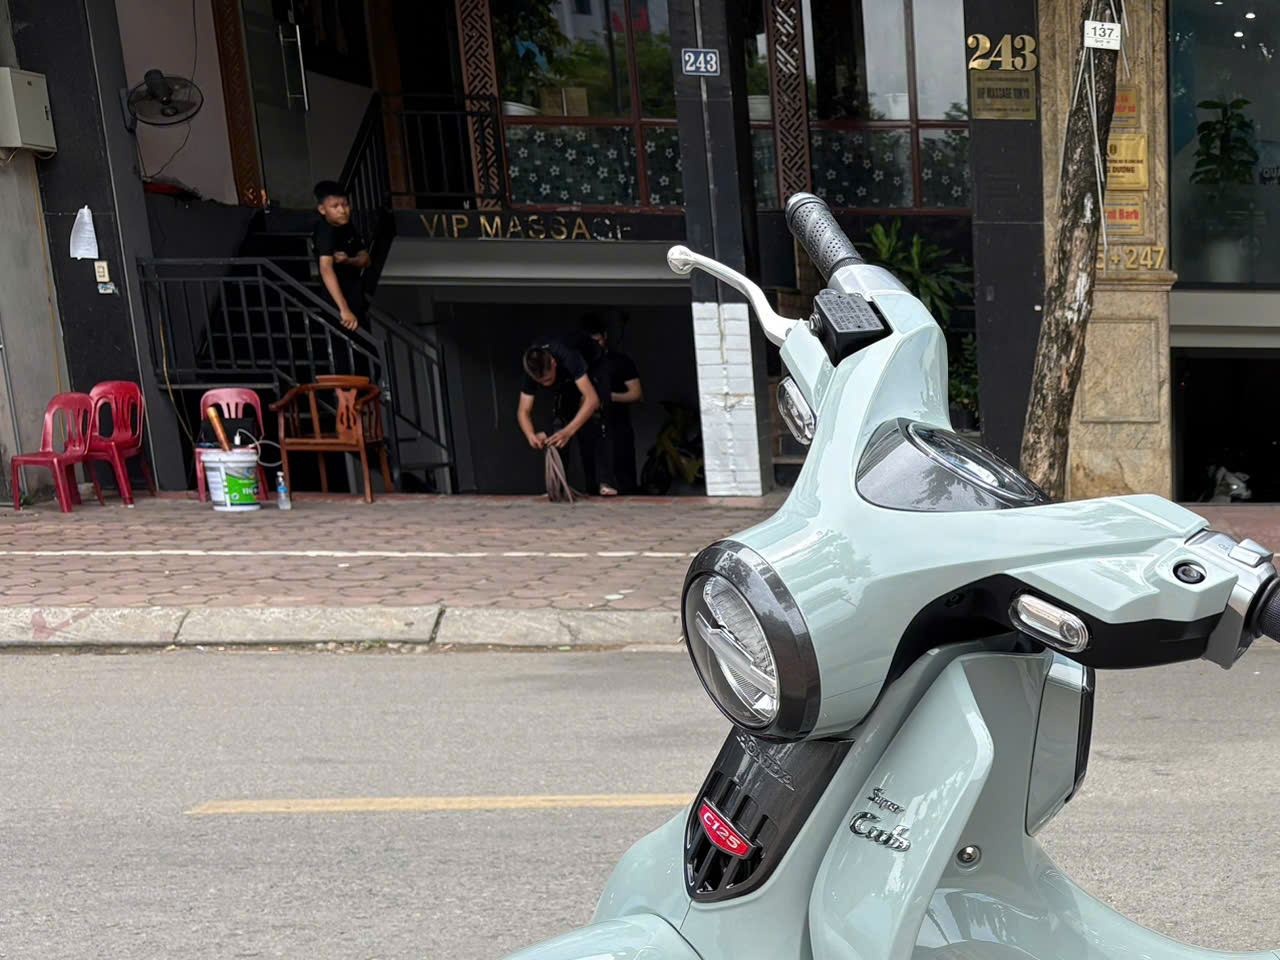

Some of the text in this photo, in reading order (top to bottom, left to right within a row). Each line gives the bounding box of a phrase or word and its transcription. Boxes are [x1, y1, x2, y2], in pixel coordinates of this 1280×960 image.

[1090, 26, 1114, 38] 137
[684, 51, 717, 72] 243
[967, 33, 1038, 71] 243
[420, 214, 470, 239] VIP
[1125, 246, 1166, 270] 247
[867, 787, 905, 814] Super
[703, 811, 741, 849] C125
[849, 811, 911, 852] Cub
